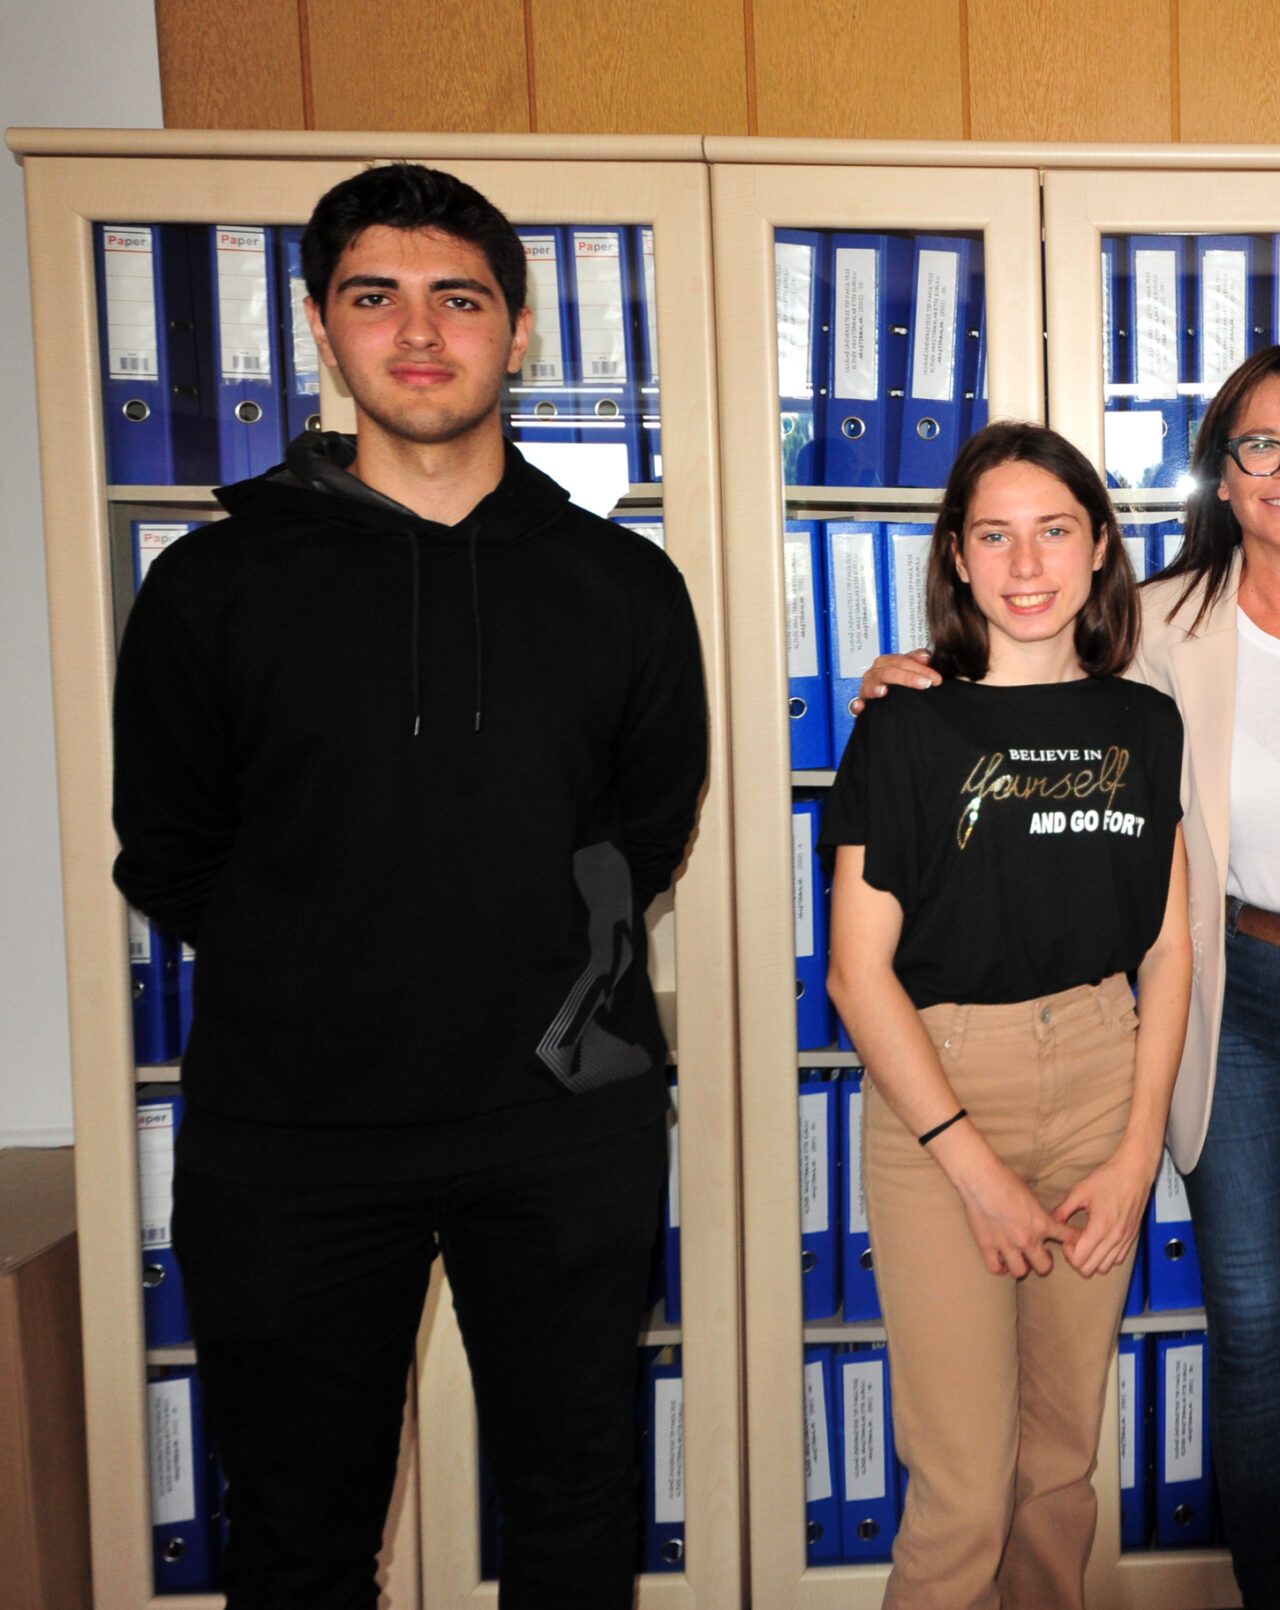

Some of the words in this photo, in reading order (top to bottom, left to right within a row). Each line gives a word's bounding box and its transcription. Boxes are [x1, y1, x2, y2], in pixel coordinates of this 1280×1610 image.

[108, 235, 146, 247] Paper
[220, 234, 259, 247] Paper
[524, 246, 550, 256] aper
[578, 242, 613, 253] Paper
[144, 533, 176, 544] Pap
[1009, 748, 1080, 761] BELIEVE
[1084, 749, 1102, 760] IN
[1029, 812, 1066, 834] AND
[1070, 810, 1099, 832] GO
